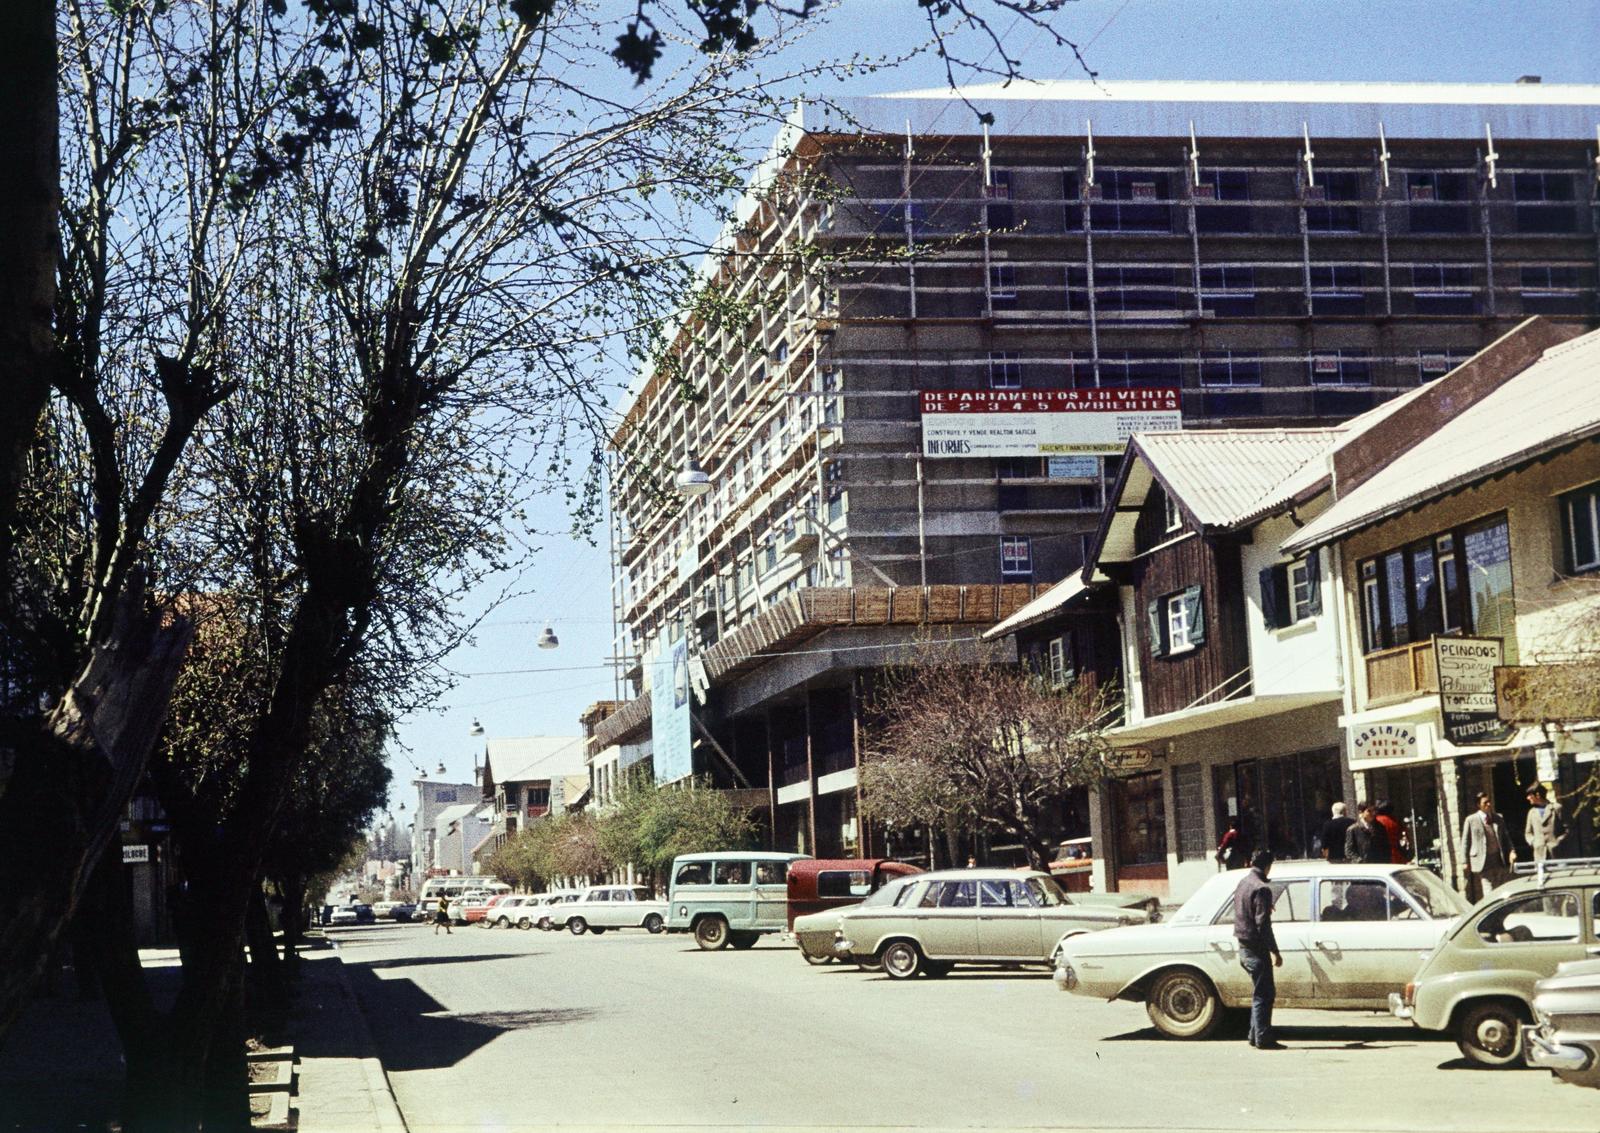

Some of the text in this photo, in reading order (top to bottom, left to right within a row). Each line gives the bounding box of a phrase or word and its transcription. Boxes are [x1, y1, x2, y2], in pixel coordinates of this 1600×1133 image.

[925, 390, 1176, 401] DEPARTAMENTOS EN VENTA
[924, 402, 946, 411] DE
[1065, 400, 1177, 410] AMBIENTES
[927, 439, 971, 454] INFORMES
[1441, 644, 1497, 657] PEINADOS
[1355, 726, 1416, 748] CASIMIRO
